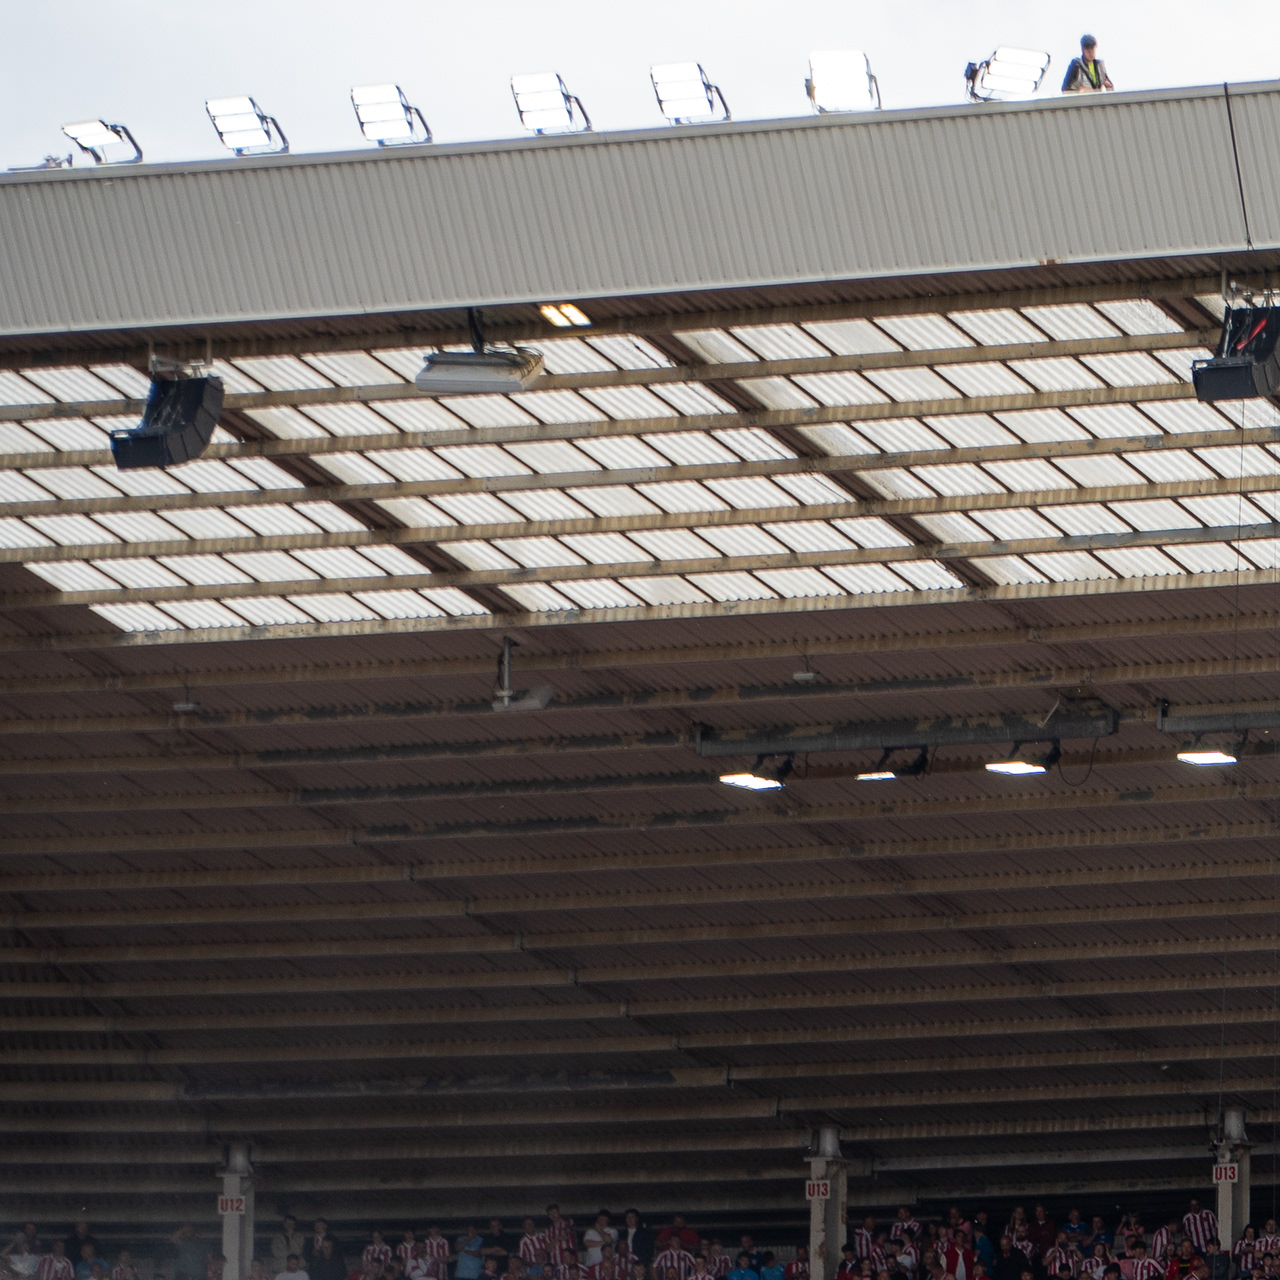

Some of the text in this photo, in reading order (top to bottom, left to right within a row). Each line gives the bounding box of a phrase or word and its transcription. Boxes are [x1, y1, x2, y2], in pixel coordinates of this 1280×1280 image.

[1215, 1166, 1236, 1181] U13
[808, 1182, 829, 1197] U13
[220, 1198, 244, 1212] U12
